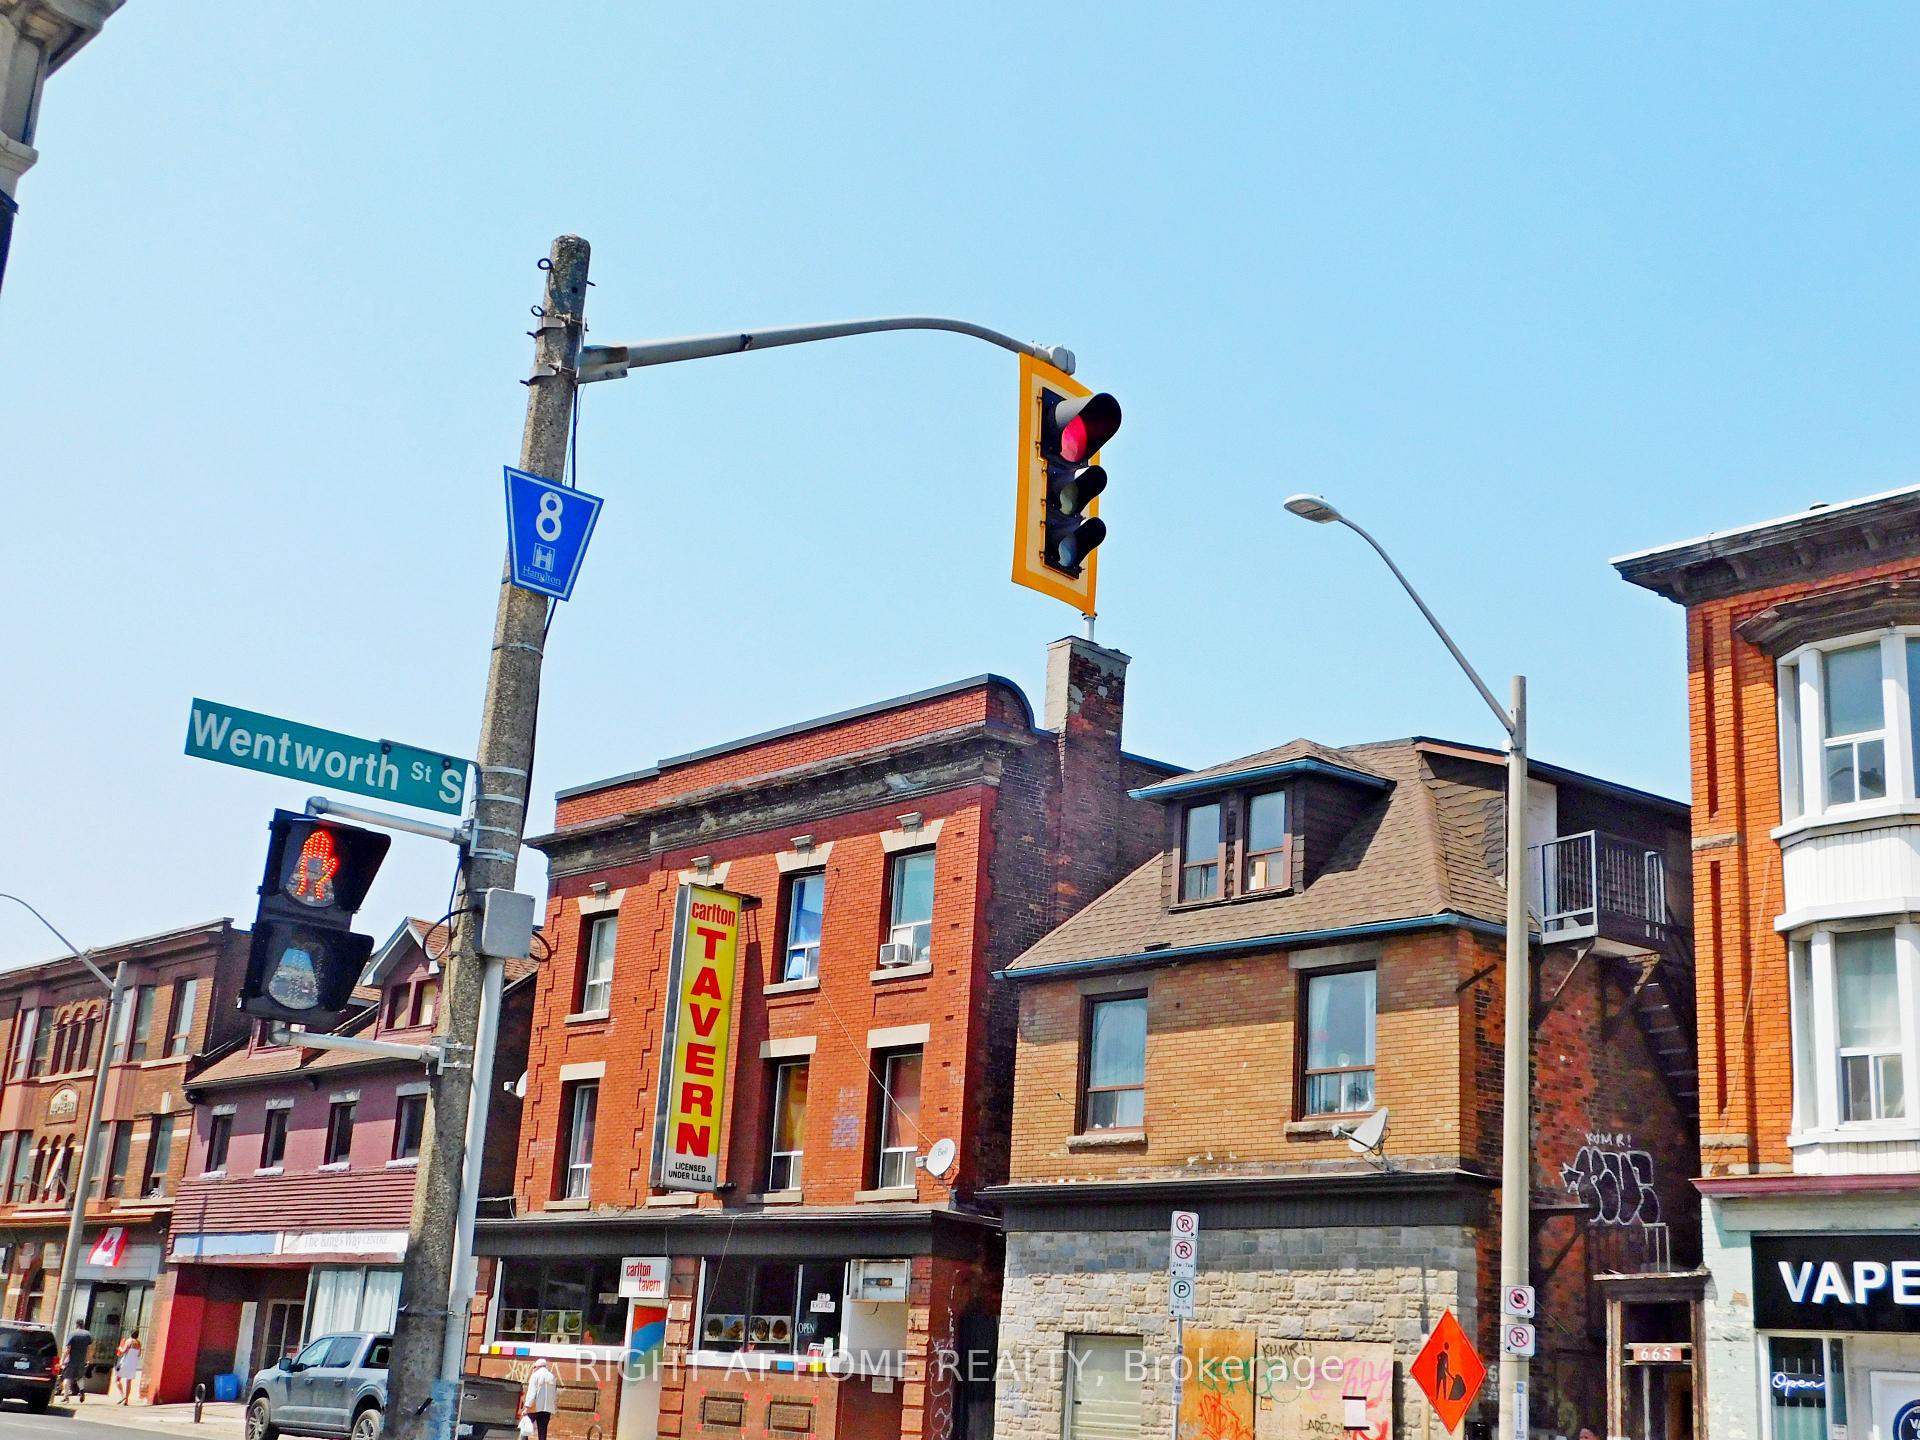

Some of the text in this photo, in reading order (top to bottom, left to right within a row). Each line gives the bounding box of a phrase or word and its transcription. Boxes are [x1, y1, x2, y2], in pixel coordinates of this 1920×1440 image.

[536, 492, 563, 541] 8
[523, 565, 561, 586] Hamilton
[193, 709, 463, 804] Wentworth St S
[691, 902, 736, 927] carlton
[676, 927, 727, 1158] TAVERN
[669, 1170, 690, 1180] UNDER
[675, 1162, 706, 1173] LICENSED
[305, 1232, 319, 1248] The
[345, 1231, 361, 1249] Way
[626, 1262, 652, 1277] carlton
[639, 1277, 661, 1292] tavern
[1778, 1260, 1920, 1305] VAPE
[798, 1322, 815, 1334] OPEN
[1641, 1347, 1672, 1361] 665
[1772, 1373, 1826, 1397] Open
